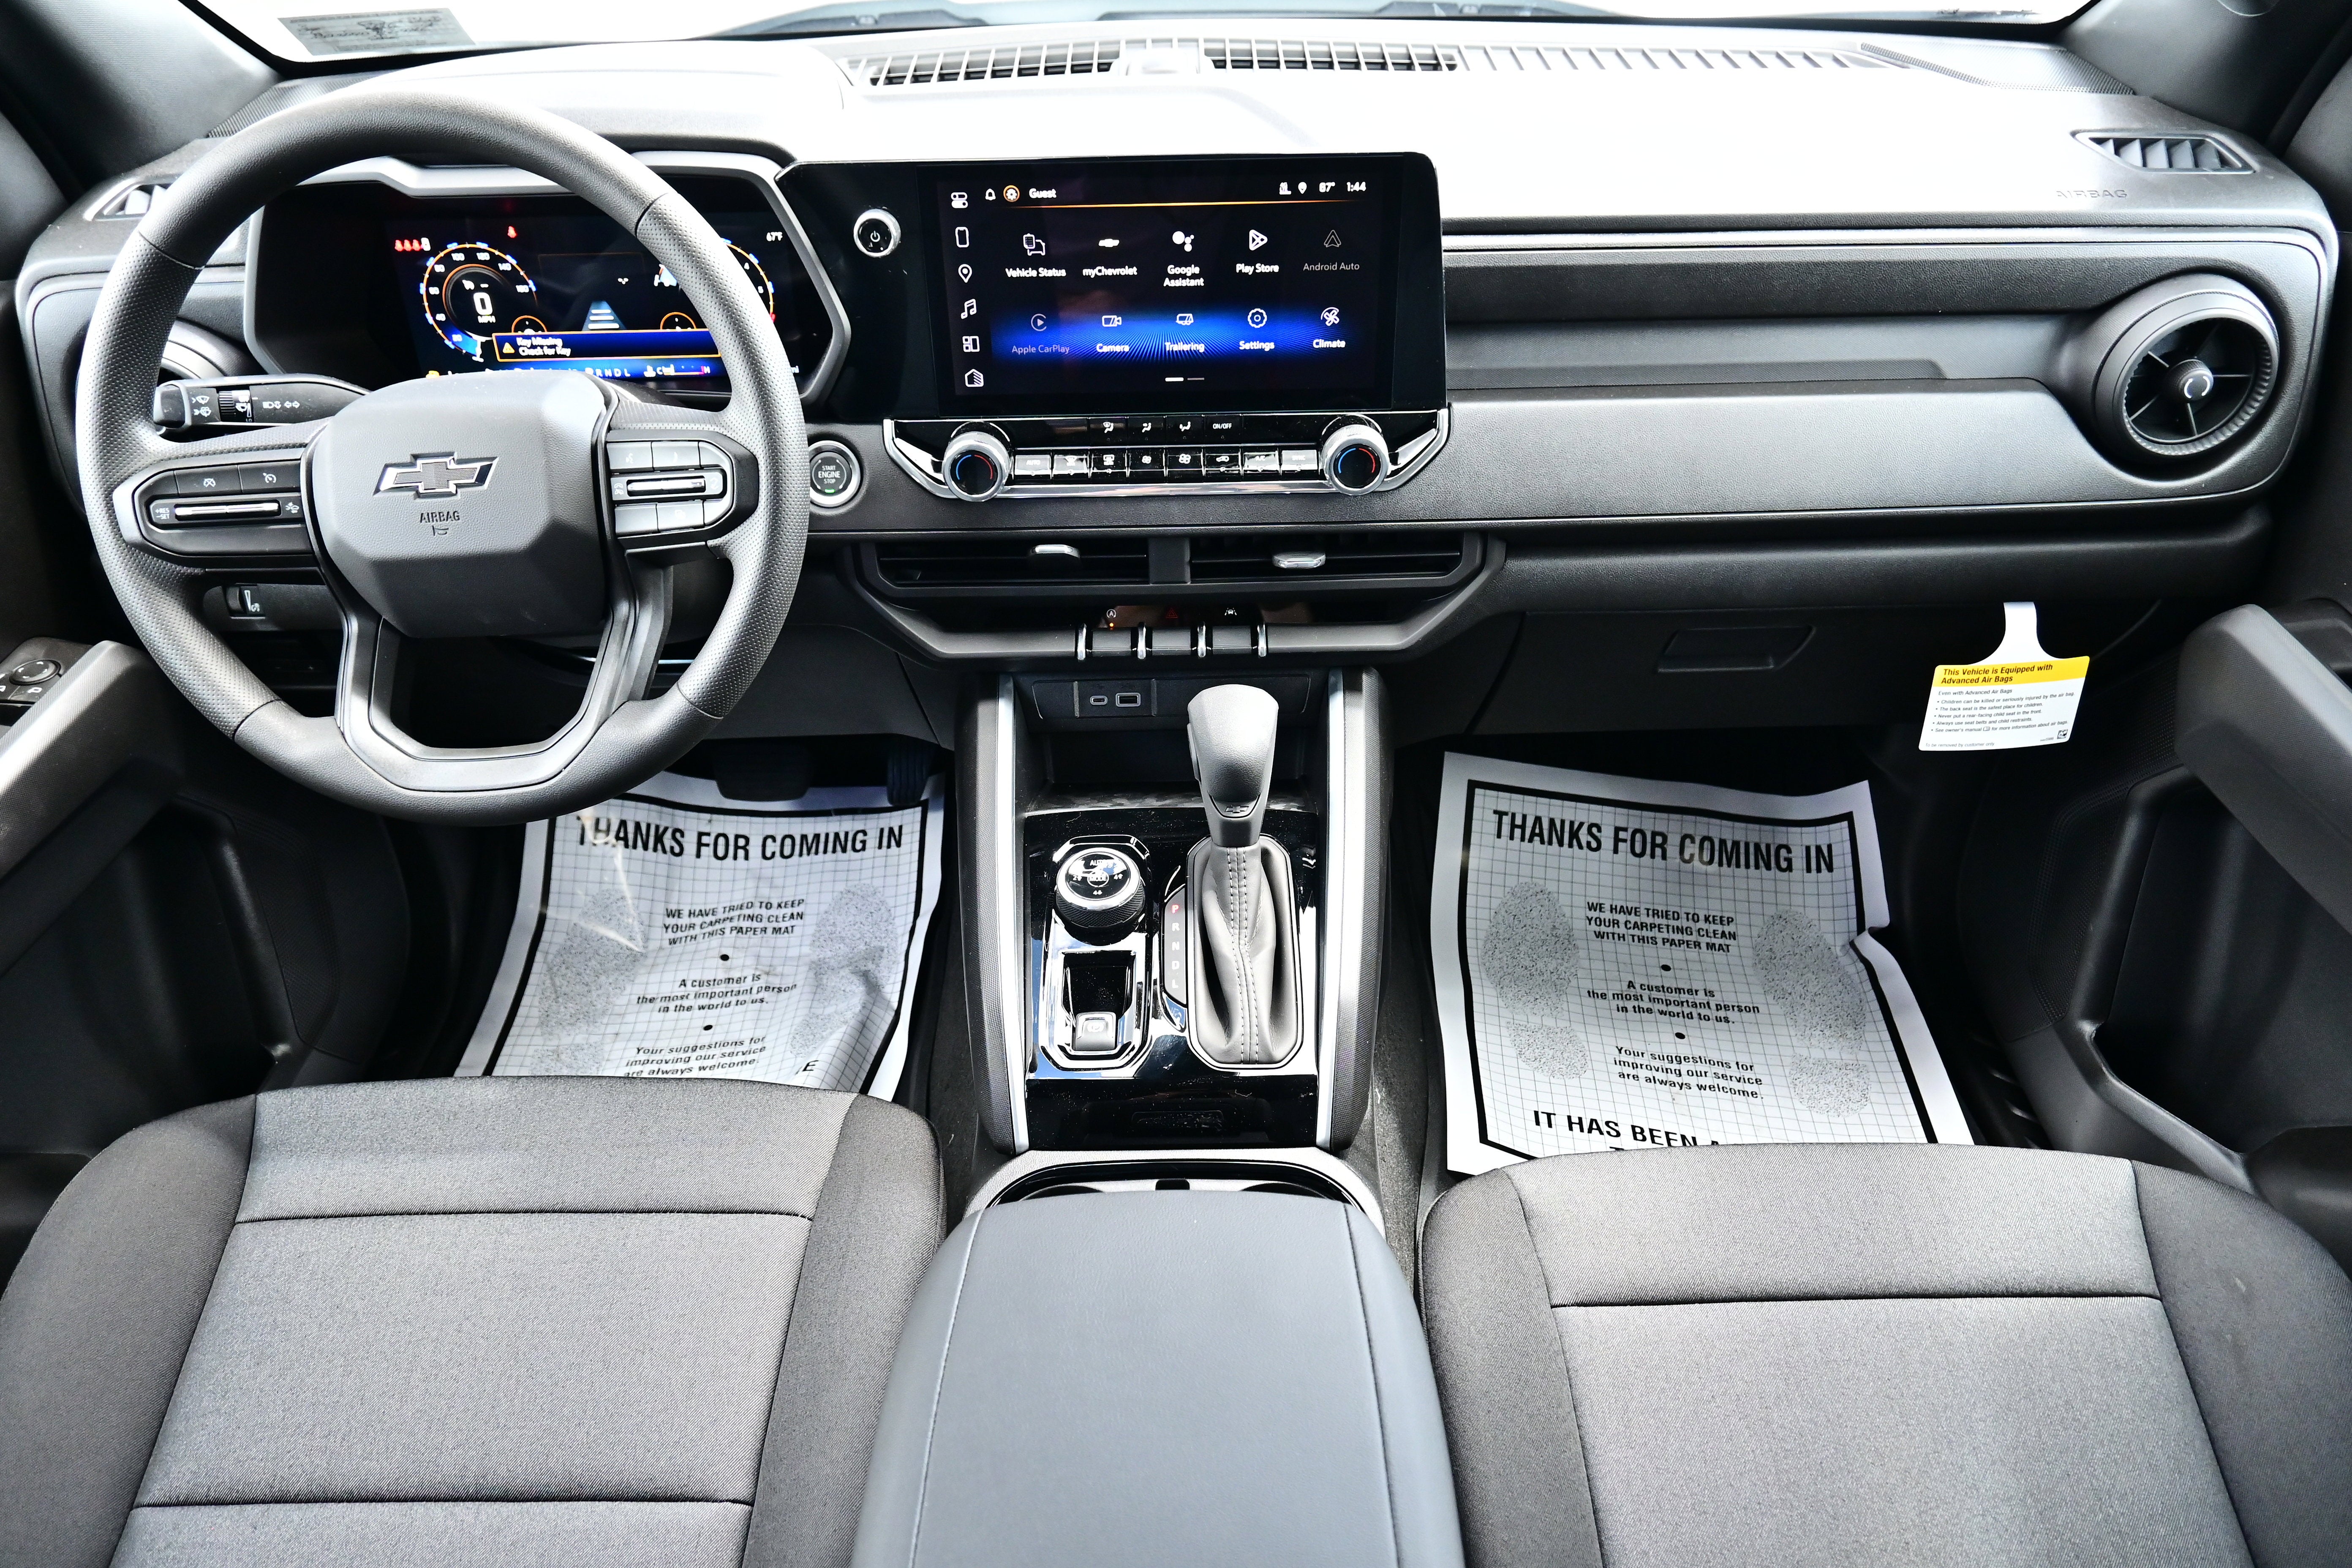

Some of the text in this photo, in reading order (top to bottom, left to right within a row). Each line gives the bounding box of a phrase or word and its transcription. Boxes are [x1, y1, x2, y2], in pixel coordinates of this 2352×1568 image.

[1346, 182, 1367, 192] 1:44
[1029, 188, 1057, 199] Guest
[2056, 190, 2127, 199] AIRBAG
[1005, 267, 1066, 278] Vehicle Status
[1083, 266, 1137, 278] myChevrolet
[1167, 264, 1200, 276] Google
[1236, 263, 1279, 275] Play Store
[1303, 262, 1360, 271] Android Auto
[1163, 278, 1204, 287] Assistant
[473, 292, 493, 316] 0
[1096, 343, 1130, 352] Camera
[1165, 342, 1204, 353] Trailering
[1239, 341, 1275, 351] Settings
[1312, 339, 1345, 348] Climate
[1012, 345, 1070, 355] Apple CarPlay
[420, 511, 460, 523] AIRBAG
[2001, 665, 2035, 674] Equipped
[577, 816, 903, 861] THANKS FOR COMING IN
[1493, 809, 1834, 874] THANKS FOR COMING IN
[666, 899, 804, 919] WE HAVE TRIED TO KEEP
[1172, 904, 1179, 914] P
[1587, 901, 1734, 926] WE HAVE TRIED TO KEEP
[663, 912, 803, 934] YOUR CARPETING CLEAN
[1172, 922, 1180, 931] R
[1586, 916, 1736, 941] YOUR CARPETING CLEAN
[668, 926, 795, 945] WITH THIS PAPER MAT
[1172, 941, 1180, 950] N
[1594, 931, 1731, 953] WITH THIS PAPER MAT
[1172, 961, 1180, 970] D
[679, 974, 760, 988] A customer is
[1172, 979, 1179, 988] L
[637, 984, 796, 1004] the most important person
[1627, 980, 1715, 998] A customer is
[674, 1004, 692, 1012] the
[698, 1002, 731, 1011] world
[1587, 990, 1760, 1014] the most important person
[1617, 1004, 1735, 1024] in the world to us.
[636, 1036, 765, 1055] Your suggestions for
[626, 1056, 690, 1067] improving
[721, 1045, 766, 1057] service
[1616, 1045, 1754, 1071] Your suggestions for
[624, 1058, 759, 1077] are always welcome.
[1614, 1057, 1763, 1085] improving our service
[1618, 1071, 1764, 1099] are always welcome.
[1534, 1110, 1698, 1147] IT HAS BEEN
